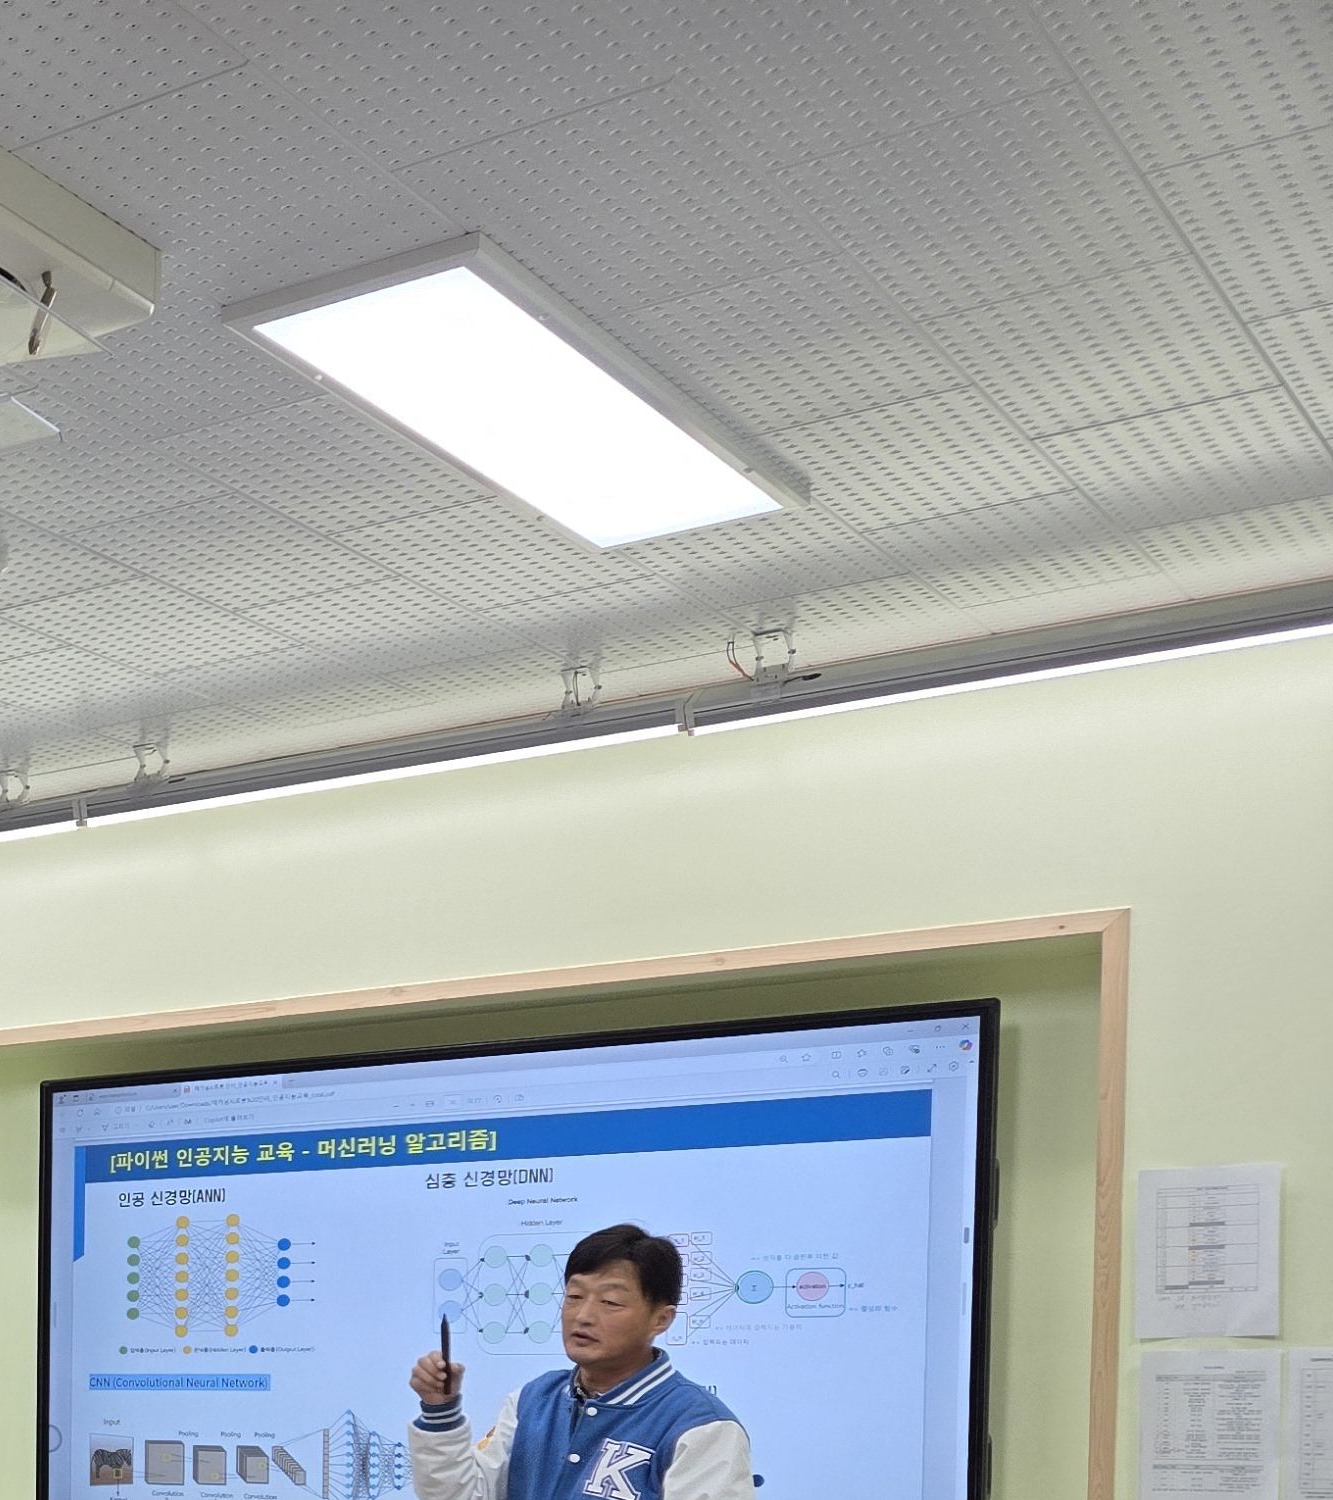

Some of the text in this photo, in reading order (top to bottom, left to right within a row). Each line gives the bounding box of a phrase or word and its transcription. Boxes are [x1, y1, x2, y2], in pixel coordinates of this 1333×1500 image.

[110, 1151, 168, 1173] [파이썬
[176, 1145, 250, 1168] 인공지능
[257, 1141, 295, 1161] 교육
[317, 1134, 396, 1158] 머신러닝
[405, 1129, 497, 1153] 알고리즘]
[119, 1193, 144, 1207] 인공
[545, 1219, 563, 1227] Layer
[90, 1377, 268, 1389] CNN (Convolutional Neural Network)
[178, 1430, 198, 1438] Pooling
